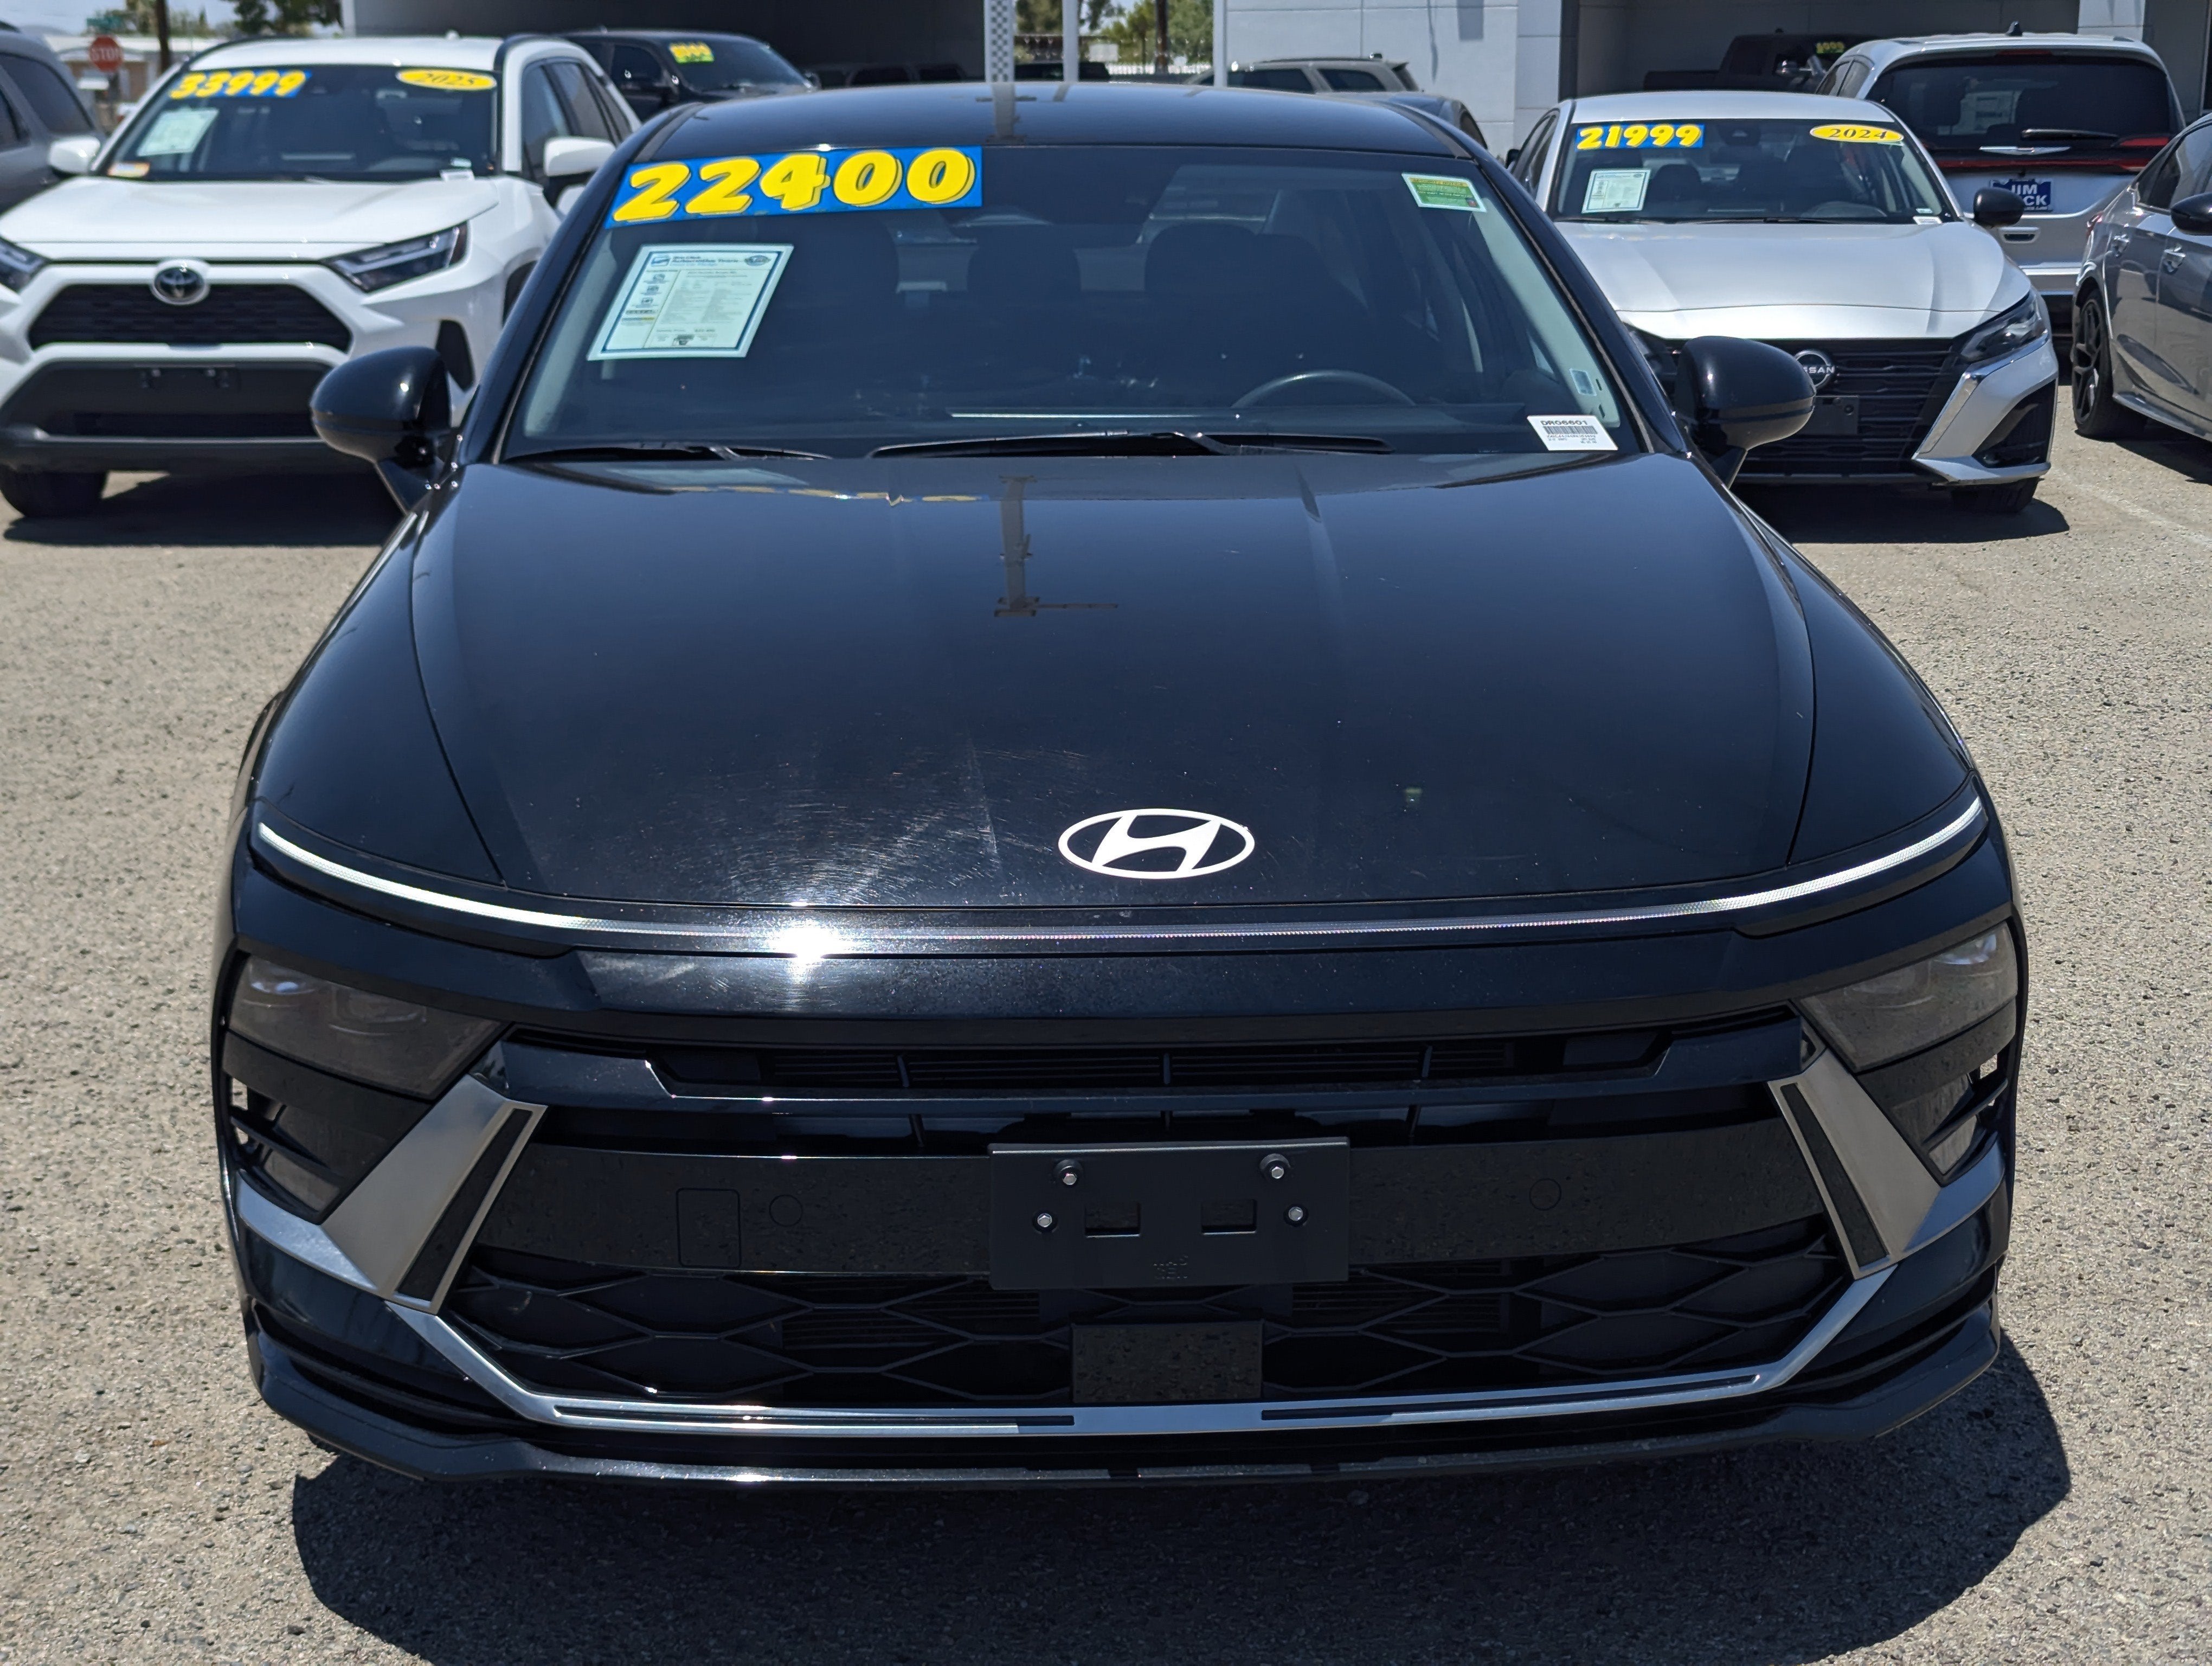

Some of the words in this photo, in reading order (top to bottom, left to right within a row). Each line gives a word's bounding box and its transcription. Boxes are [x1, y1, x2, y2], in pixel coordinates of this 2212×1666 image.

[170, 70, 306, 99] 33999
[1577, 124, 1701, 150] 21999
[1829, 129, 1888, 139] 2024
[614, 149, 975, 222] 22400
[2011, 184, 2037, 195] JIM
